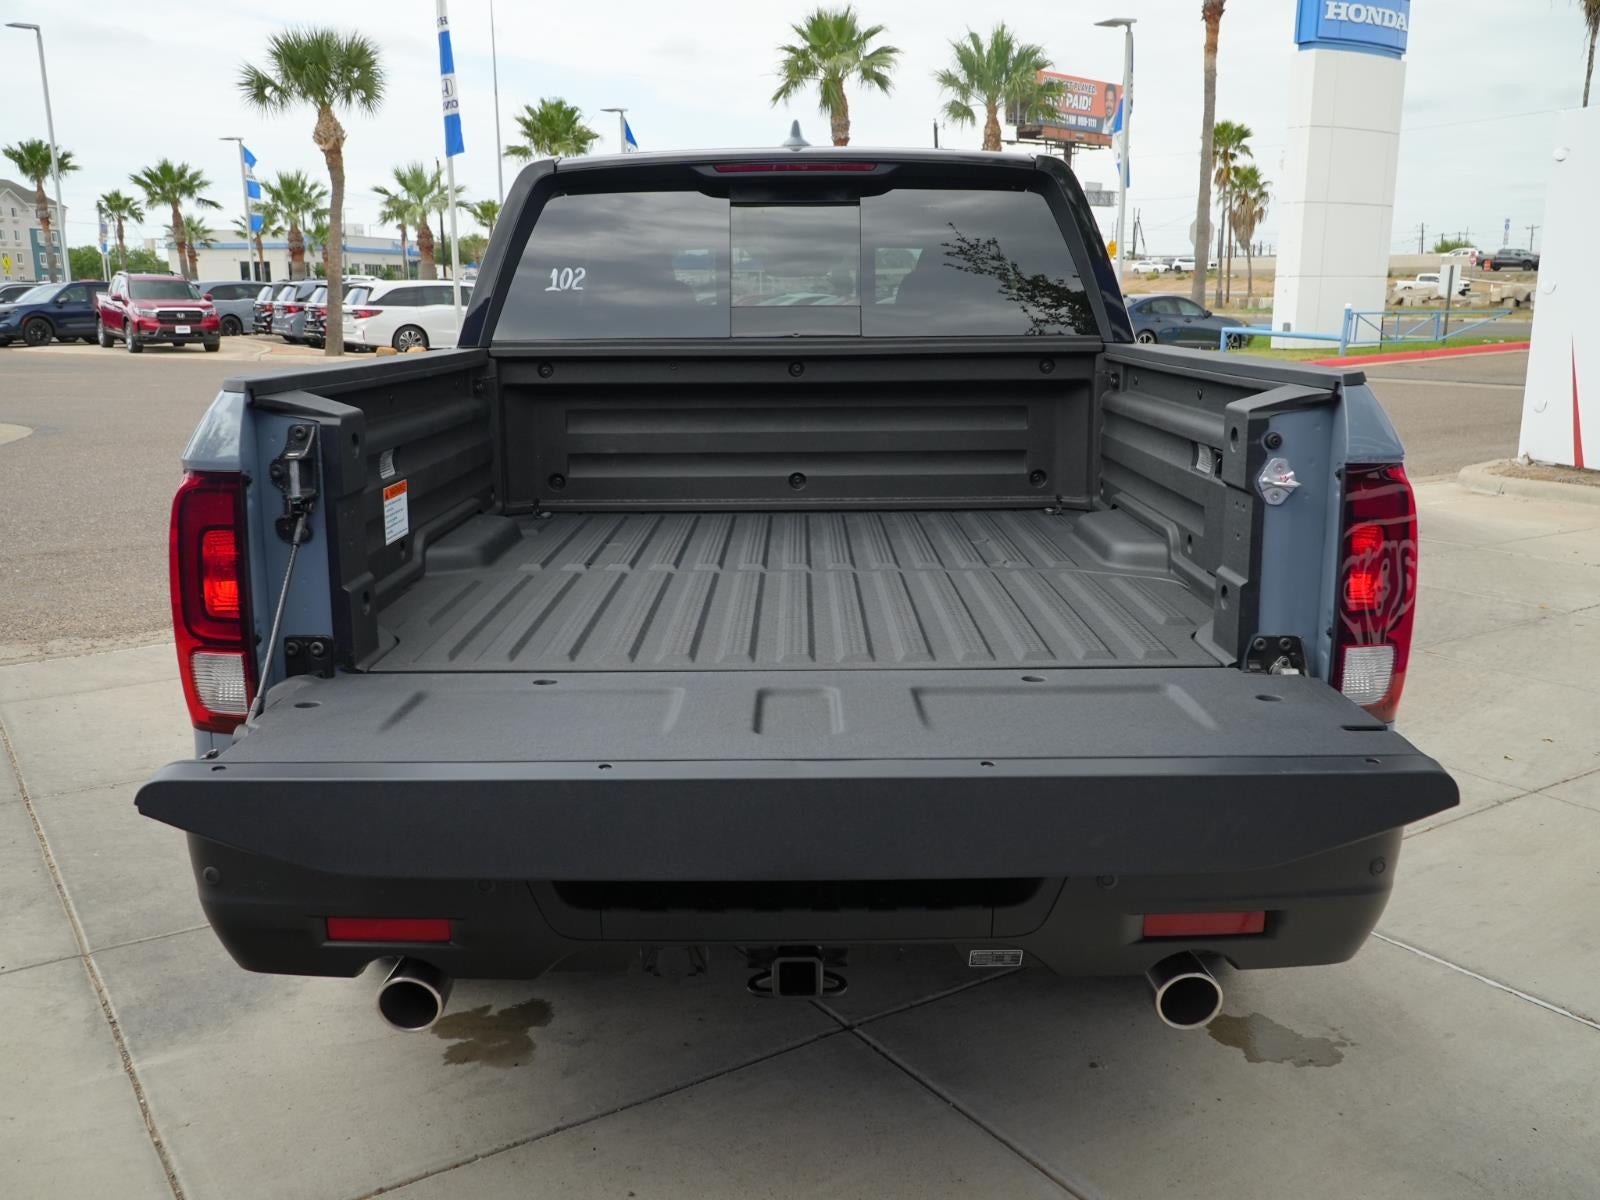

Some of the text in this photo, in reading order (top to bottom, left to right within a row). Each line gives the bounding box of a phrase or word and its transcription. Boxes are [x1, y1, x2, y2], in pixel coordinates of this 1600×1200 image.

[1325, 1, 1408, 31] HONDA
[1066, 93, 1092, 112] PAID!
[545, 267, 586, 291] 102
